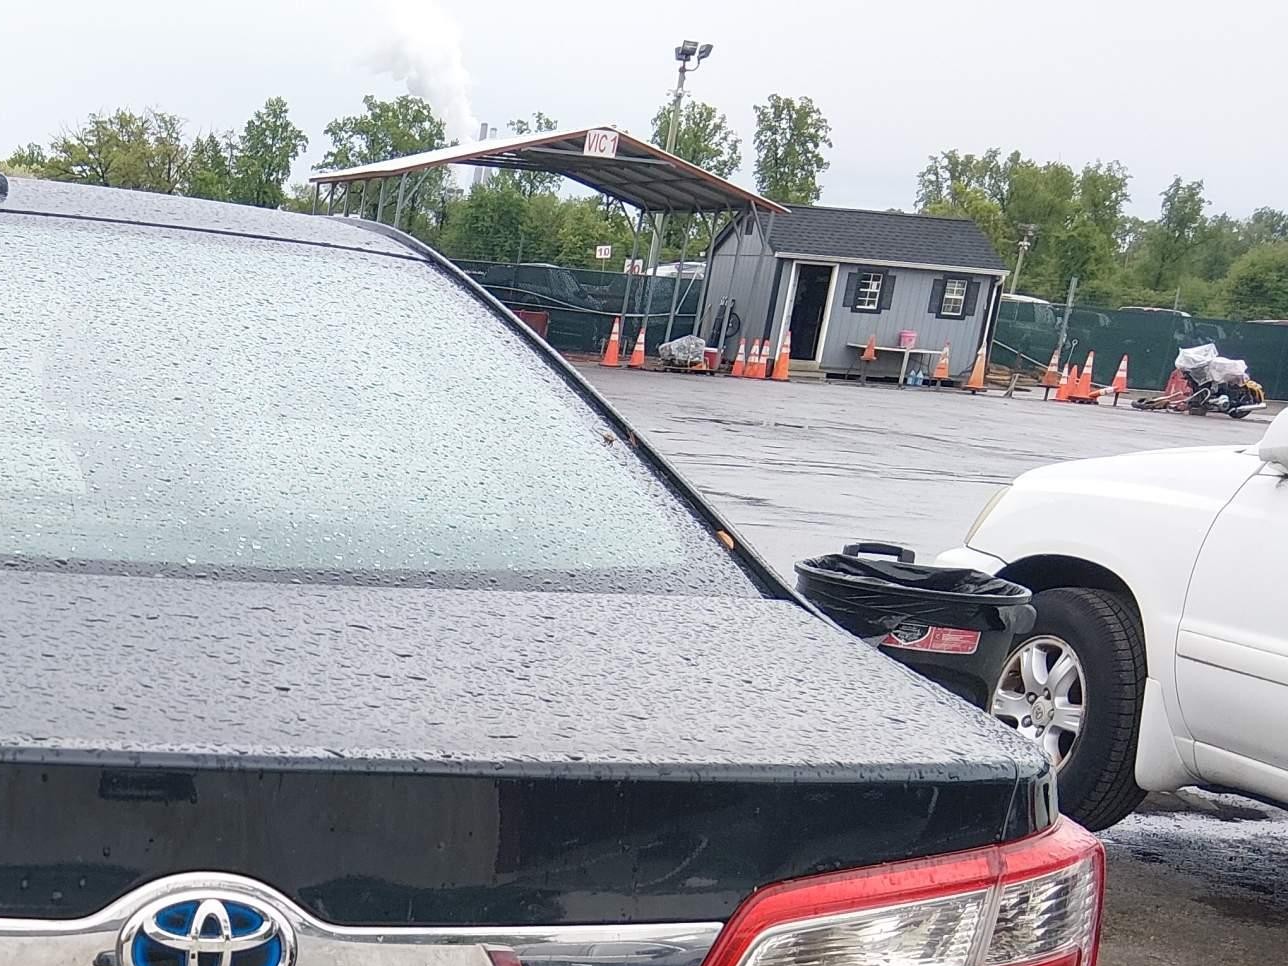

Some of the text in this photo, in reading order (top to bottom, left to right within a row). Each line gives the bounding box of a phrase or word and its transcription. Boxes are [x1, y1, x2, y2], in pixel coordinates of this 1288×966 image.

[588, 133, 617, 153] VIC 1
[598, 247, 610, 256] 10
